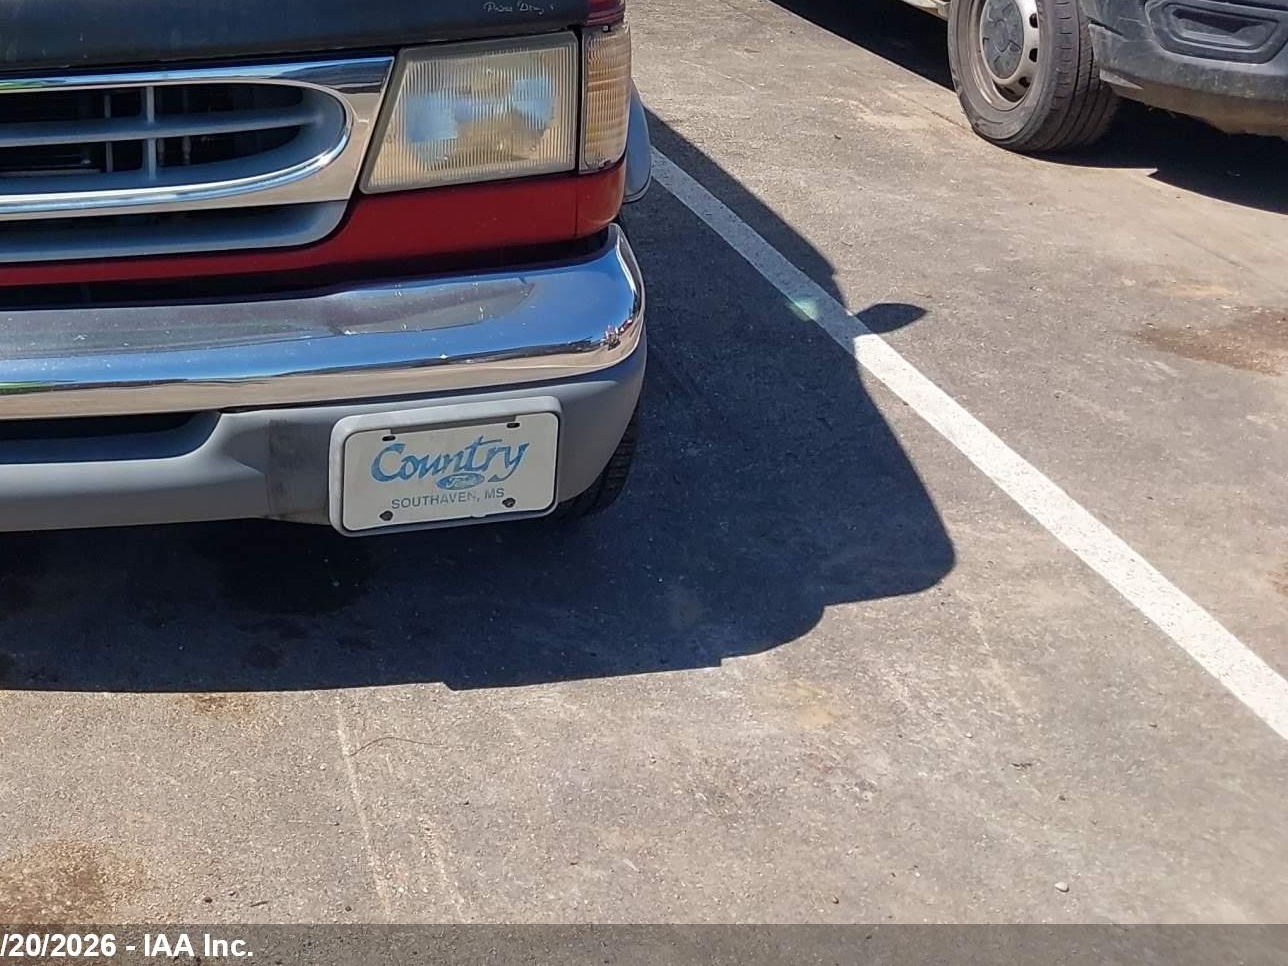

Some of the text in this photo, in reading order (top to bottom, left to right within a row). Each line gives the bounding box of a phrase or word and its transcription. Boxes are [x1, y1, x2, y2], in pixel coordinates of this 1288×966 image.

[371, 435, 530, 483] Country
[391, 487, 505, 510] SOUTHAVEN, MS
